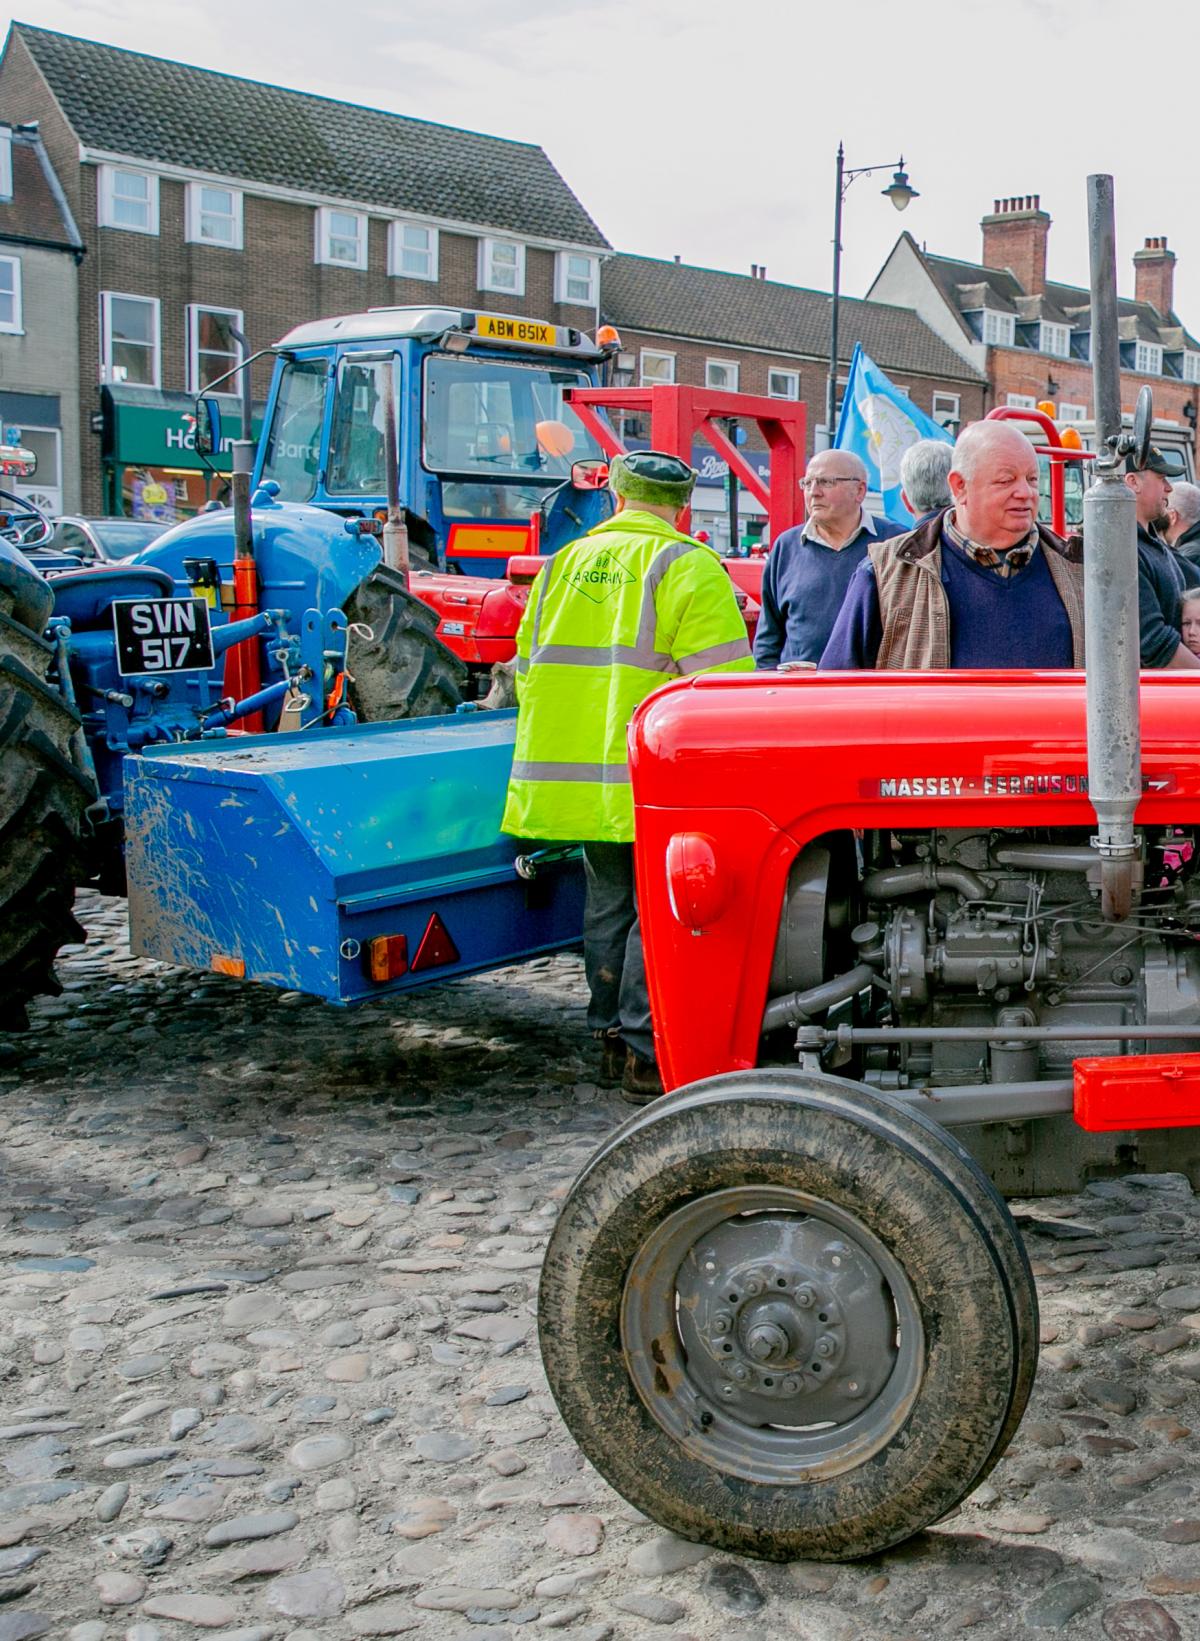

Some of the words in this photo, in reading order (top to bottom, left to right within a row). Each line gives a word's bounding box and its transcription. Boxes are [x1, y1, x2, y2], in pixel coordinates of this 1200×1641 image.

[488, 320, 514, 337] ABW
[518, 324, 548, 342] 851X
[131, 602, 196, 635] SVN
[142, 637, 190, 669] 517
[880, 777, 963, 796] MASSEY
